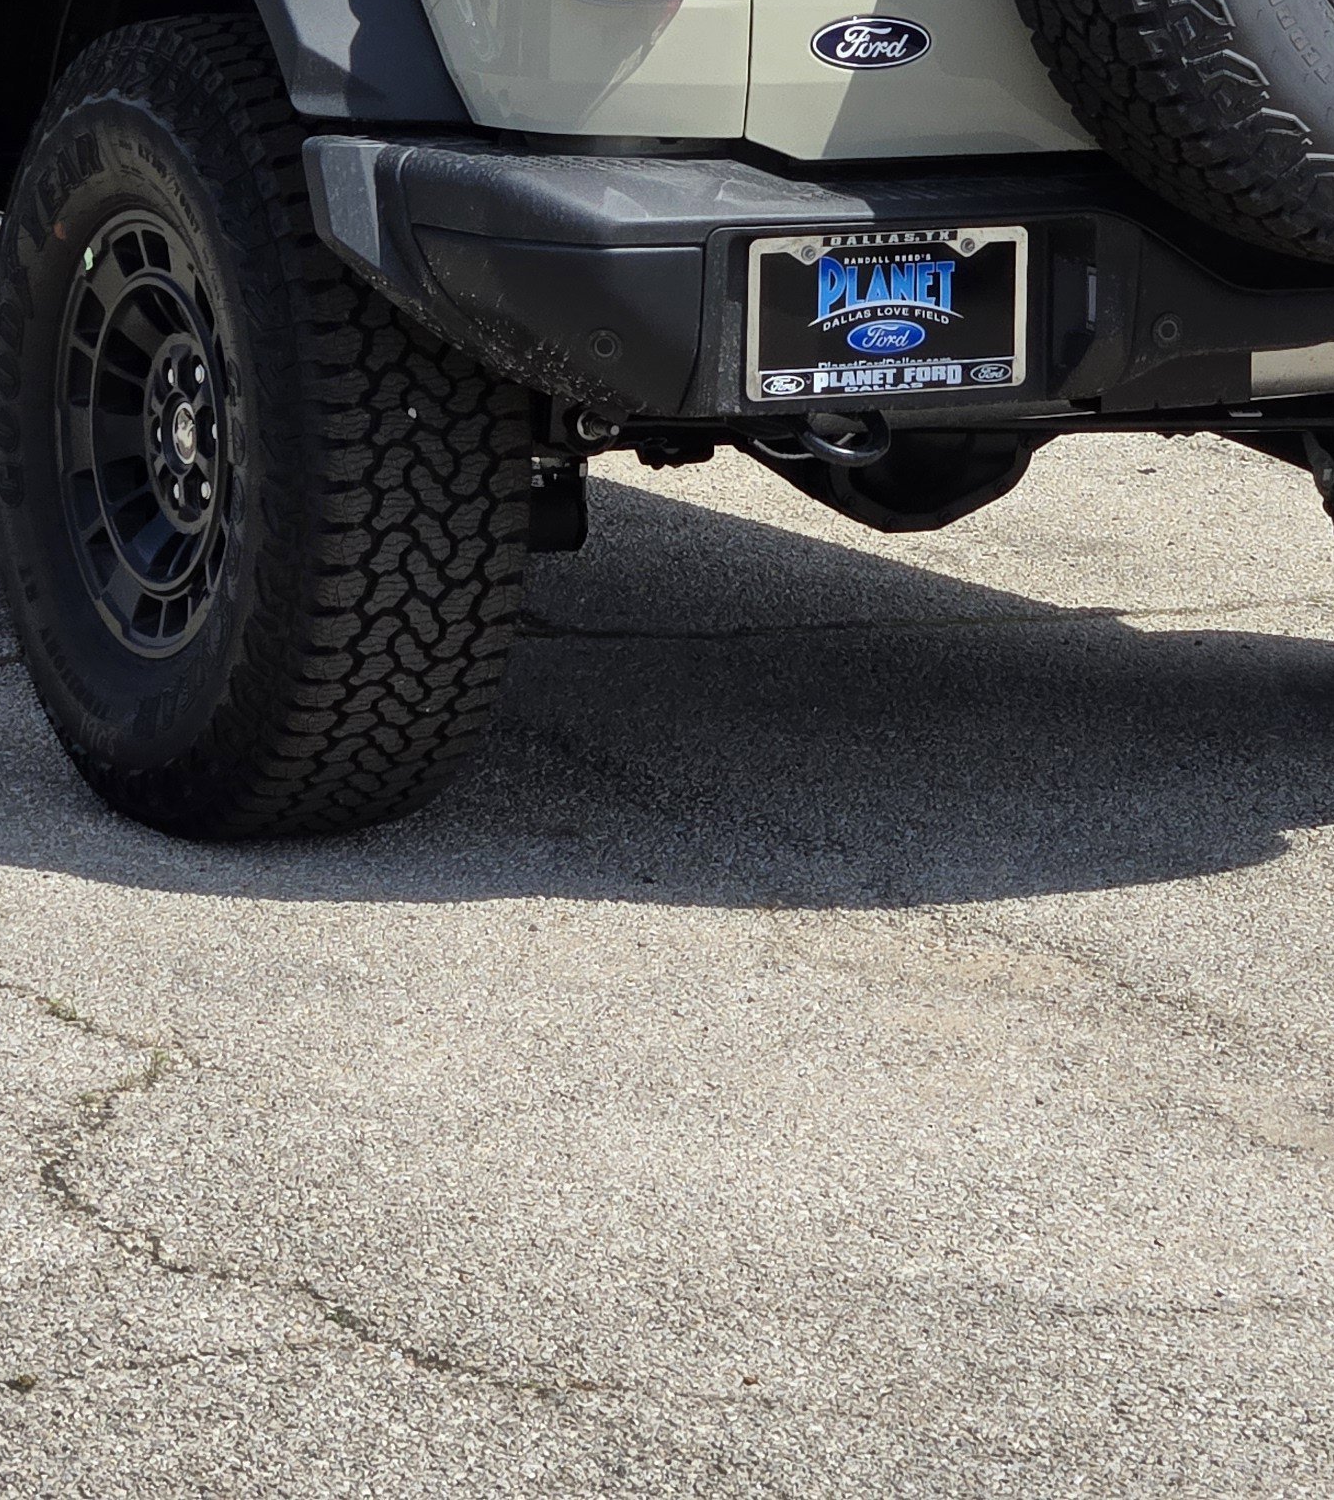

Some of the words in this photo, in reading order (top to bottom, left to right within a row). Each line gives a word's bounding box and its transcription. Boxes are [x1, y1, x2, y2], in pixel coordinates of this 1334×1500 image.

[836, 24, 909, 60] Ford
[843, 255, 890, 265] RANDALL
[894, 253, 932, 263] REED'S
[817, 256, 956, 319] PLANET
[822, 308, 872, 332] DALLAS
[877, 306, 910, 318] LOVE
[914, 308, 950, 326] FIELD
[861, 323, 910, 349] Ford
[812, 368, 897, 394] PLANET
[903, 364, 963, 385] FORD
[844, 382, 924, 393] DALLAS
